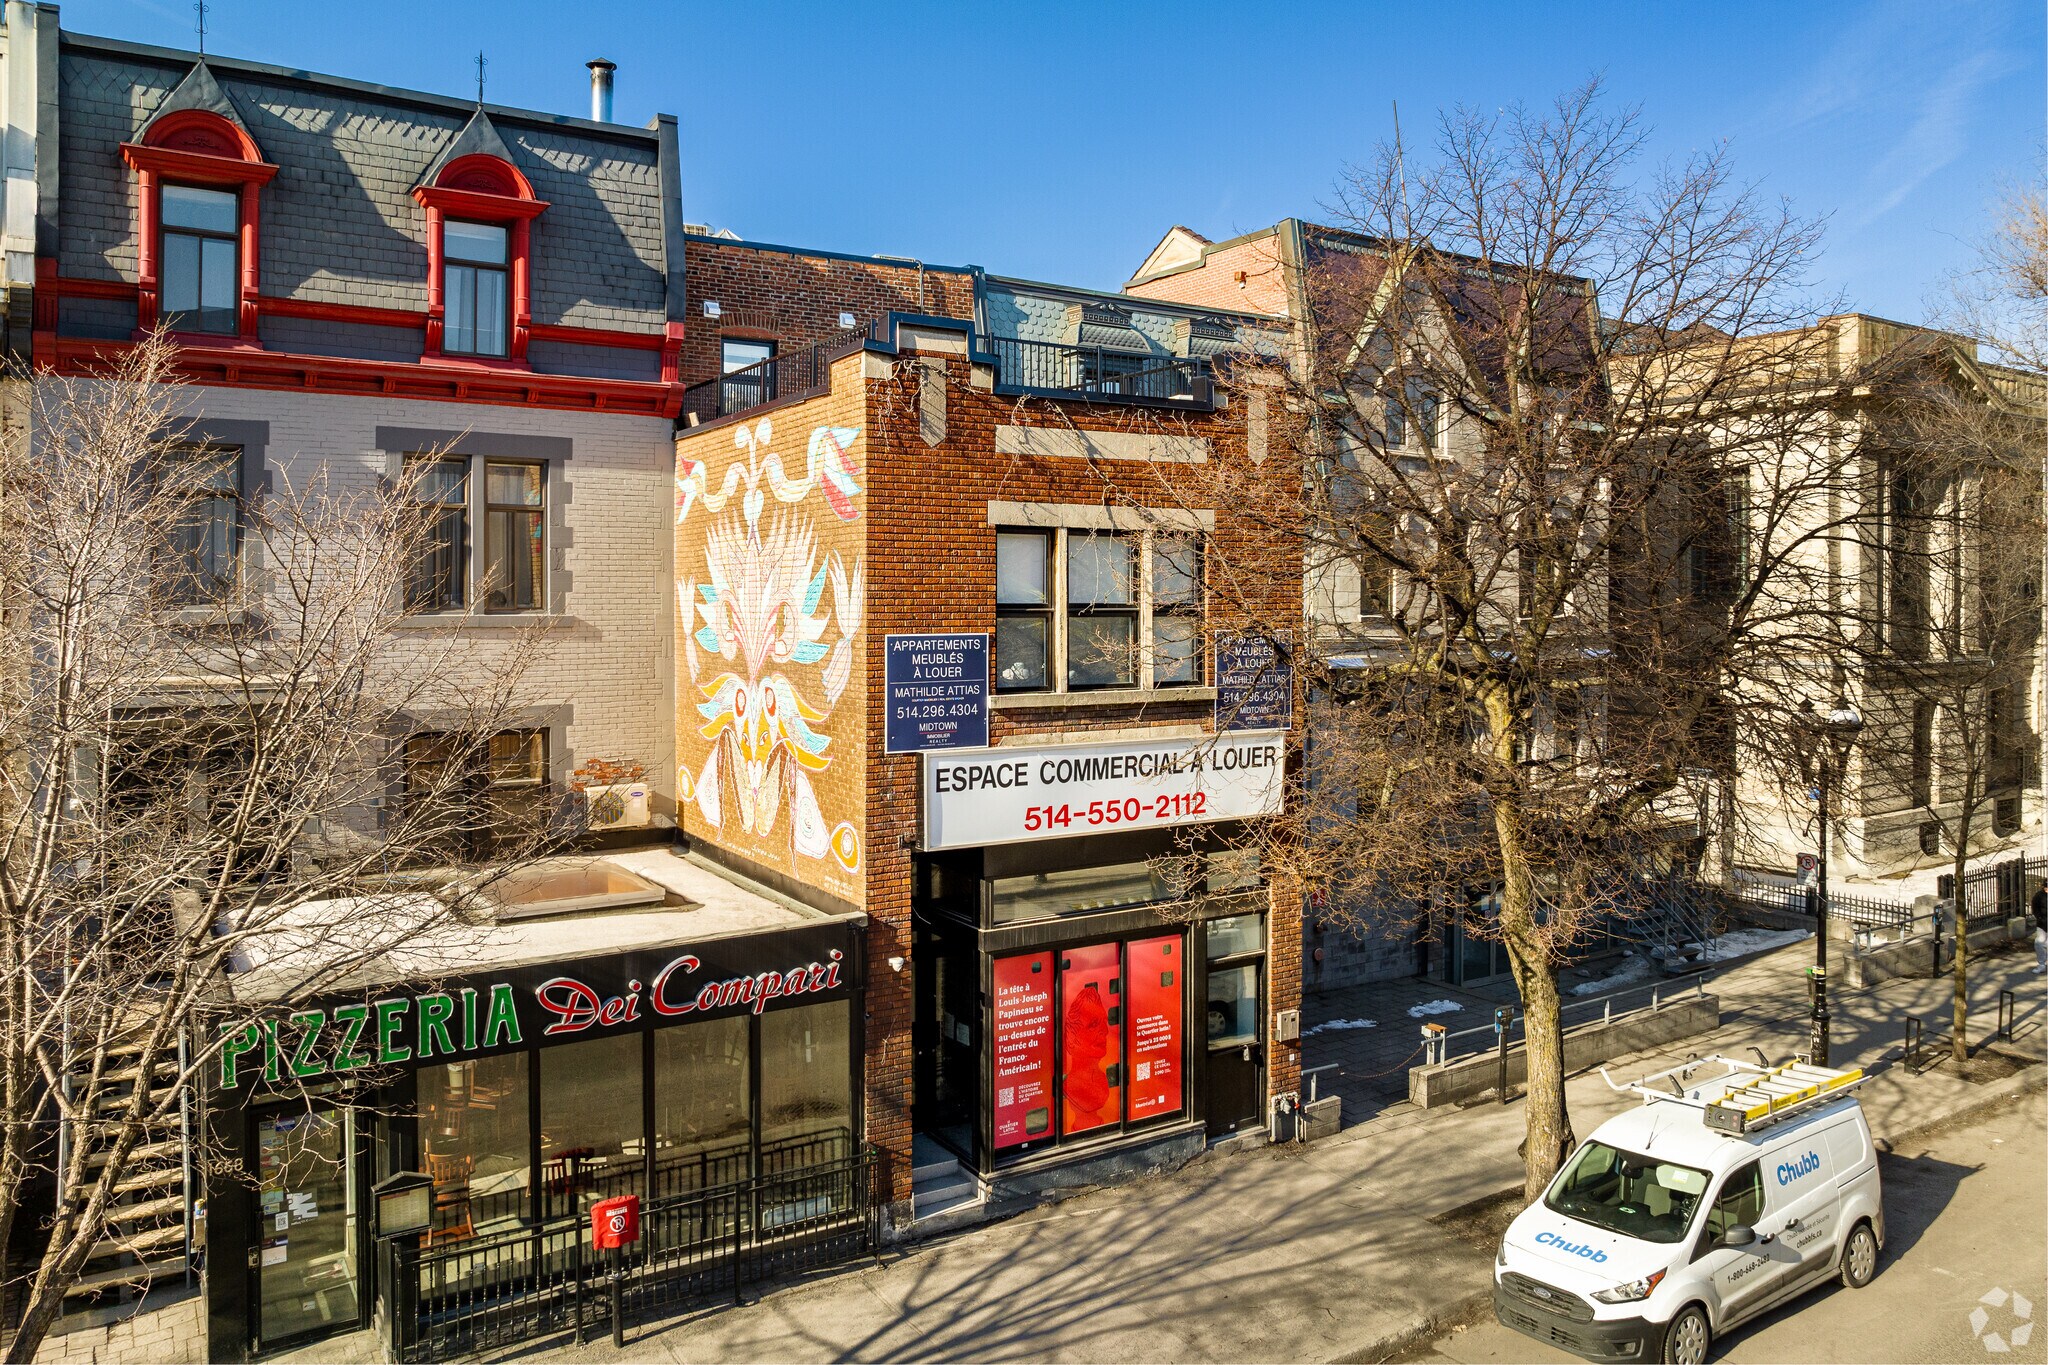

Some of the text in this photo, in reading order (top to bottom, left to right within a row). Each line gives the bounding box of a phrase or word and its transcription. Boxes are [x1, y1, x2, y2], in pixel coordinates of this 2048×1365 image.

[894, 639, 980, 652] APPARTEMENTS
[912, 652, 964, 665] MEUBLÉS
[914, 666, 962, 678] À LOUER
[895, 684, 980, 698] MATHILDE ATTIAS
[896, 704, 978, 719] 514.296.4304
[919, 721, 958, 732] MIDTOWN
[936, 762, 1028, 793] ESPACE
[1040, 752, 1184, 785] COMMERCIAL
[1212, 746, 1276, 771] LOUER
[1024, 792, 1206, 832] 514-550-2112
[998, 983, 1030, 996] La tête à
[998, 992, 1048, 1007] Louis-Joseph
[219, 948, 843, 1090] PIZZERIA Dei Compari
[998, 1006, 1034, 1019] Papineau
[998, 1015, 1050, 1030] trouve encore
[1136, 1022, 1157, 1030] commerce
[998, 1026, 1046, 1042] au-dessus de
[1141, 1028, 1158, 1036] Quartier
[998, 1039, 1038, 1054] l'entrée du
[1143, 1043, 1168, 1051] subventions
[998, 1054, 1028, 1065] Franco-
[1776, 1150, 1820, 1186] Chubb
[1534, 1232, 1608, 1263] Chubb
